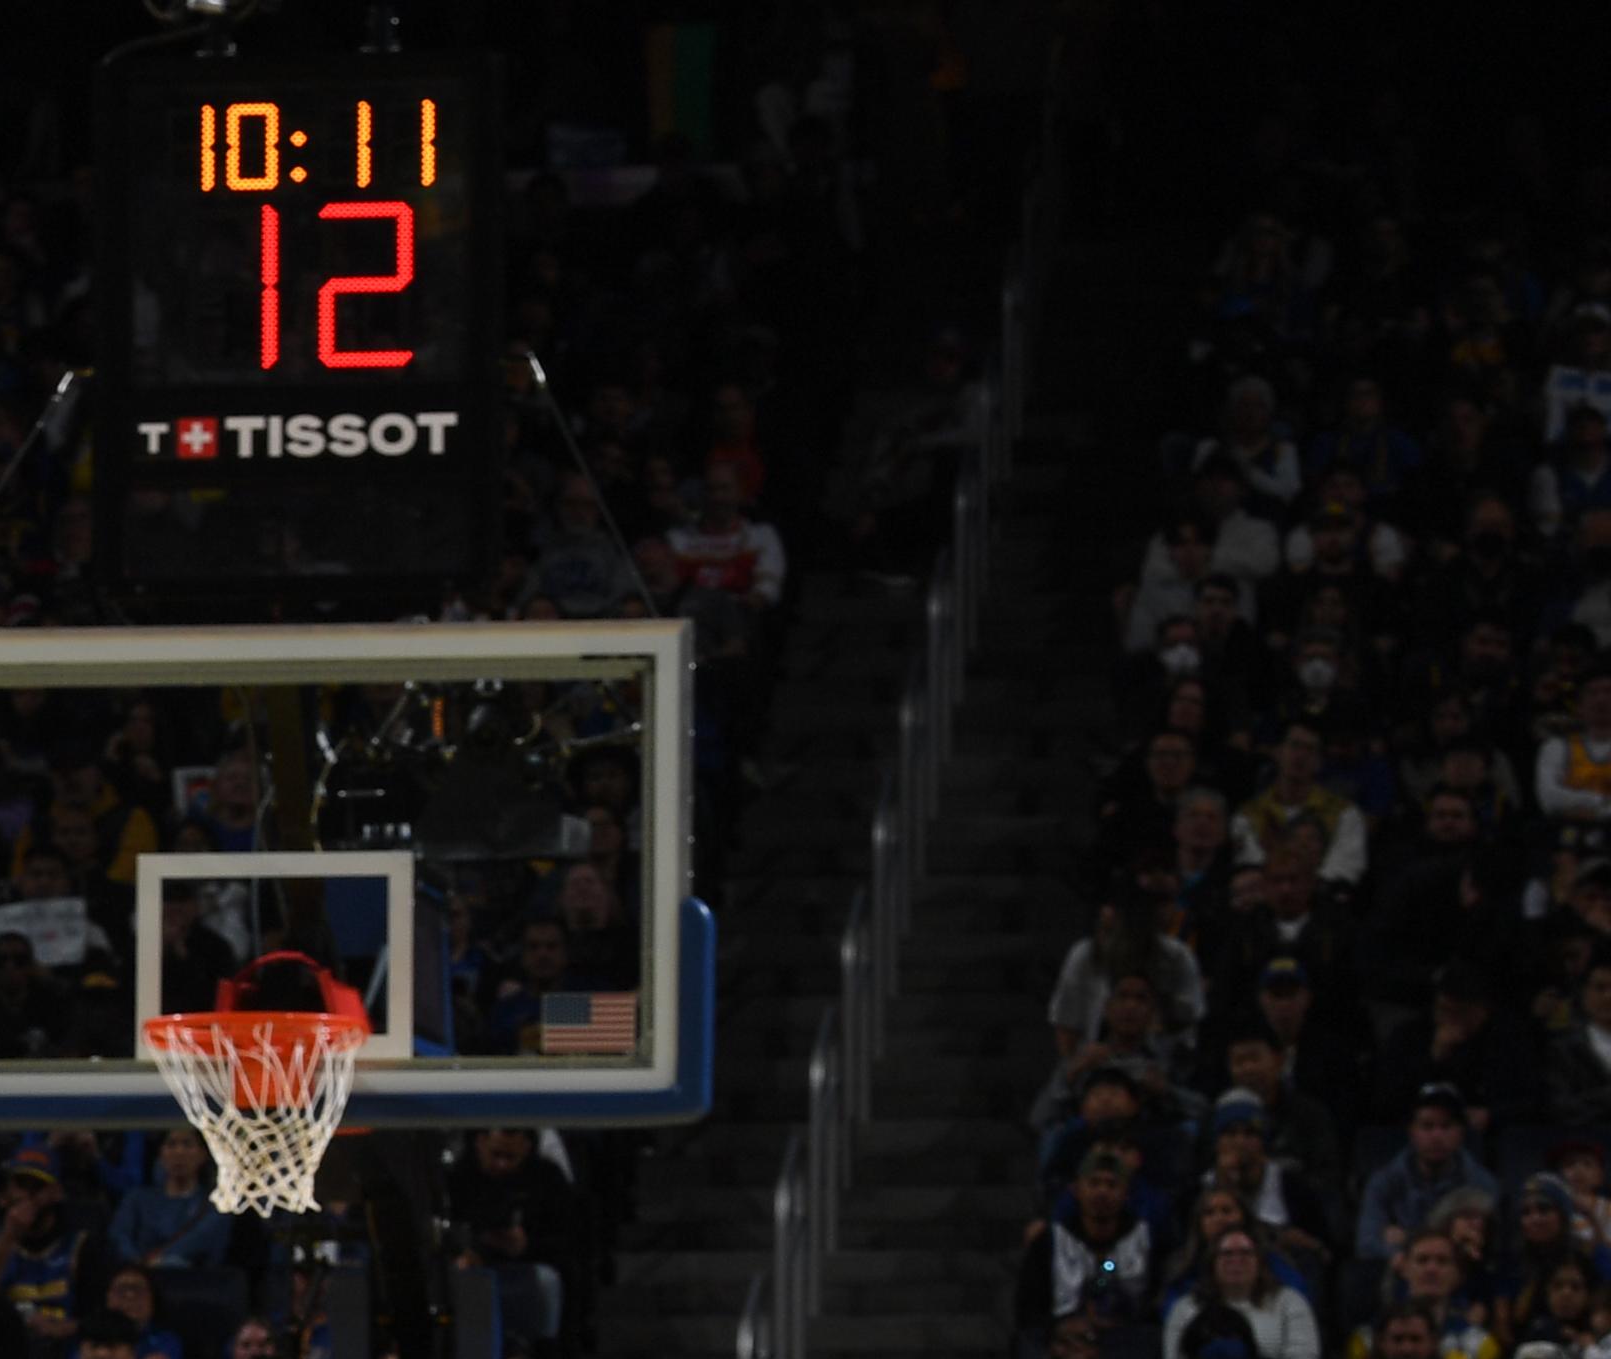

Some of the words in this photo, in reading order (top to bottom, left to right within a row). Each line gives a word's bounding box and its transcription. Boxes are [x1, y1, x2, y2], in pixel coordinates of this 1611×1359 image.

[200, 98, 437, 193] 10:11
[260, 201, 414, 370] 12
[225, 412, 459, 459] TISSOT
